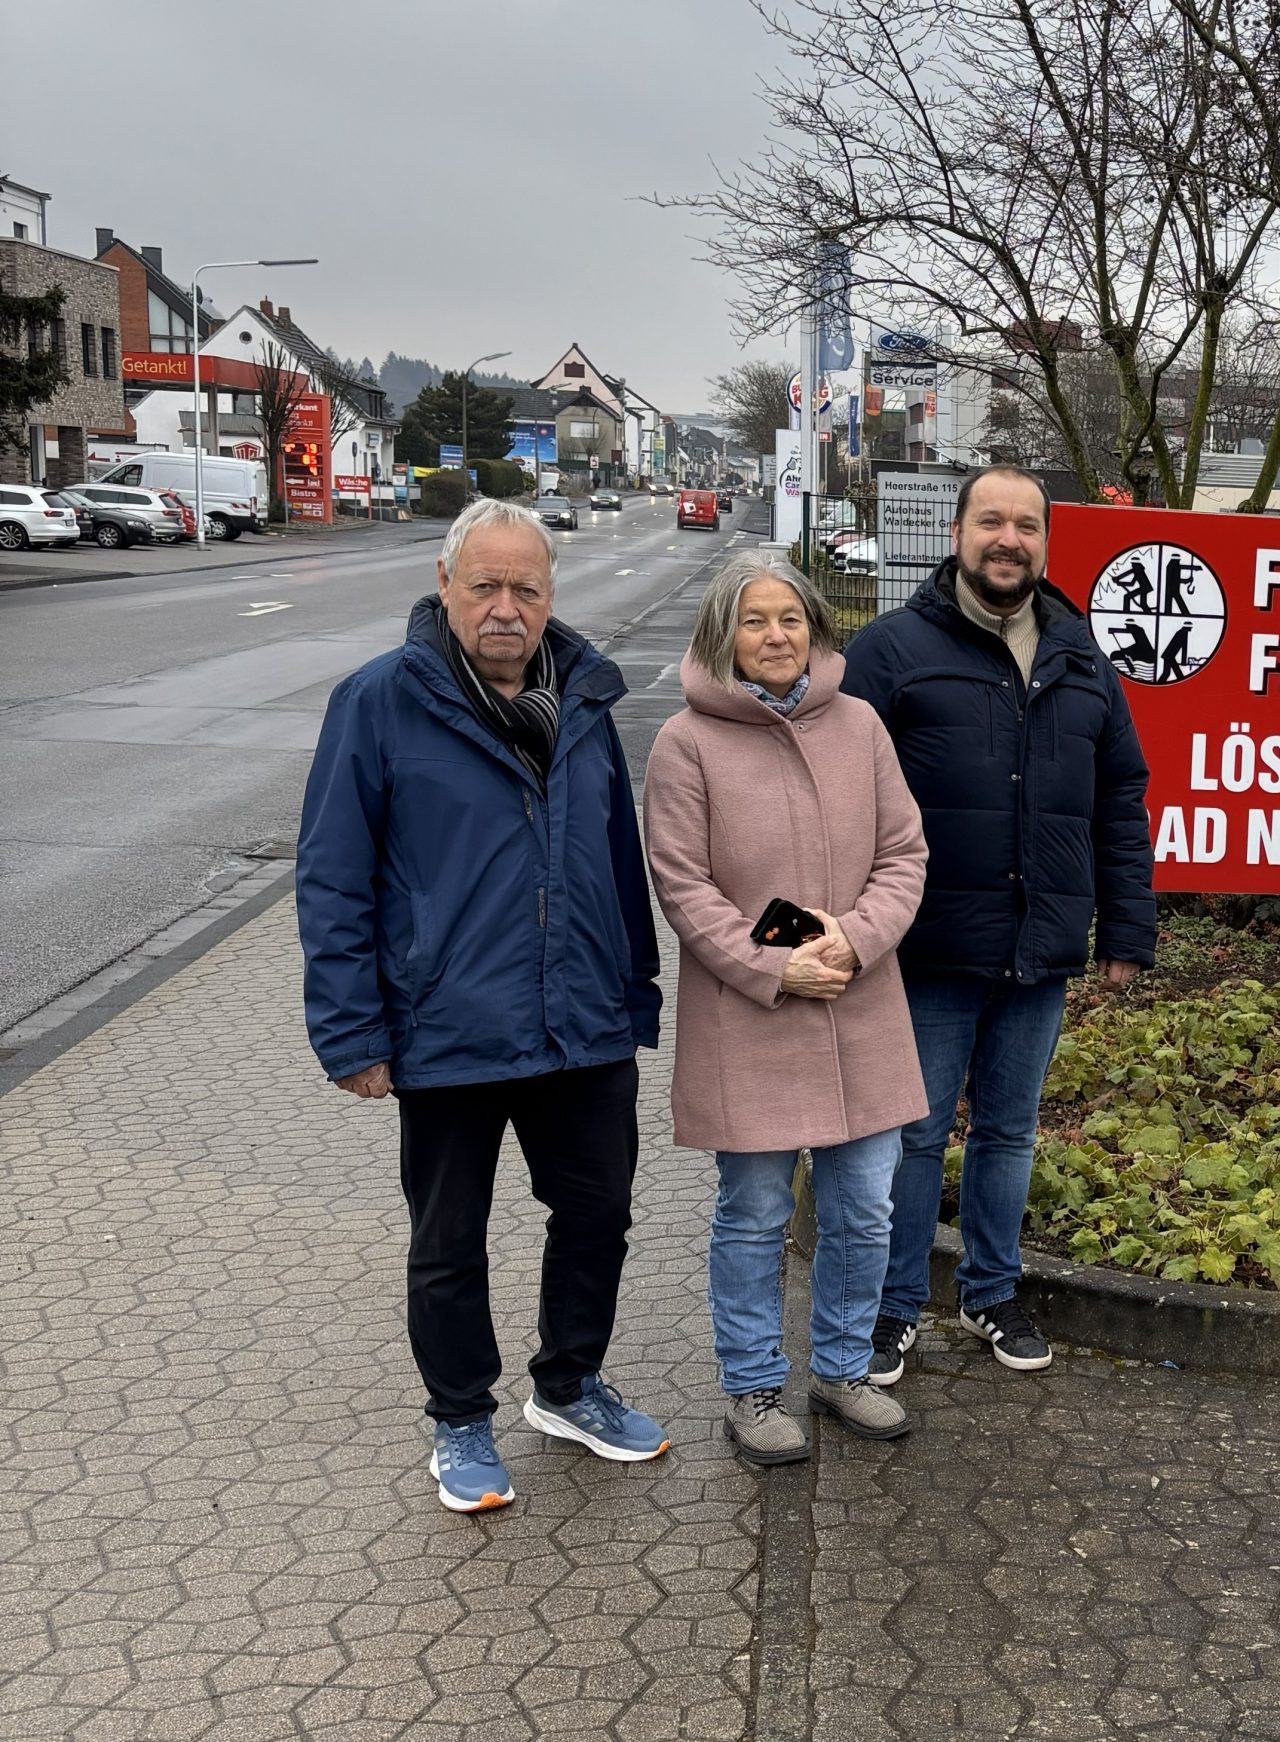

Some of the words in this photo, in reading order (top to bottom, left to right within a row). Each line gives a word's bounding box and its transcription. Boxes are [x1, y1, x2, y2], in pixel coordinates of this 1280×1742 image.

[121, 357, 187, 375] Getankt!
[872, 372, 934, 387] Service
[290, 488, 317, 497] Bistro
[885, 481, 939, 493] Heerstraße
[941, 484, 958, 493] 115
[885, 505, 932, 516] Autohaus
[884, 517, 936, 528] Waldecker
[1149, 805, 1228, 864] AD
